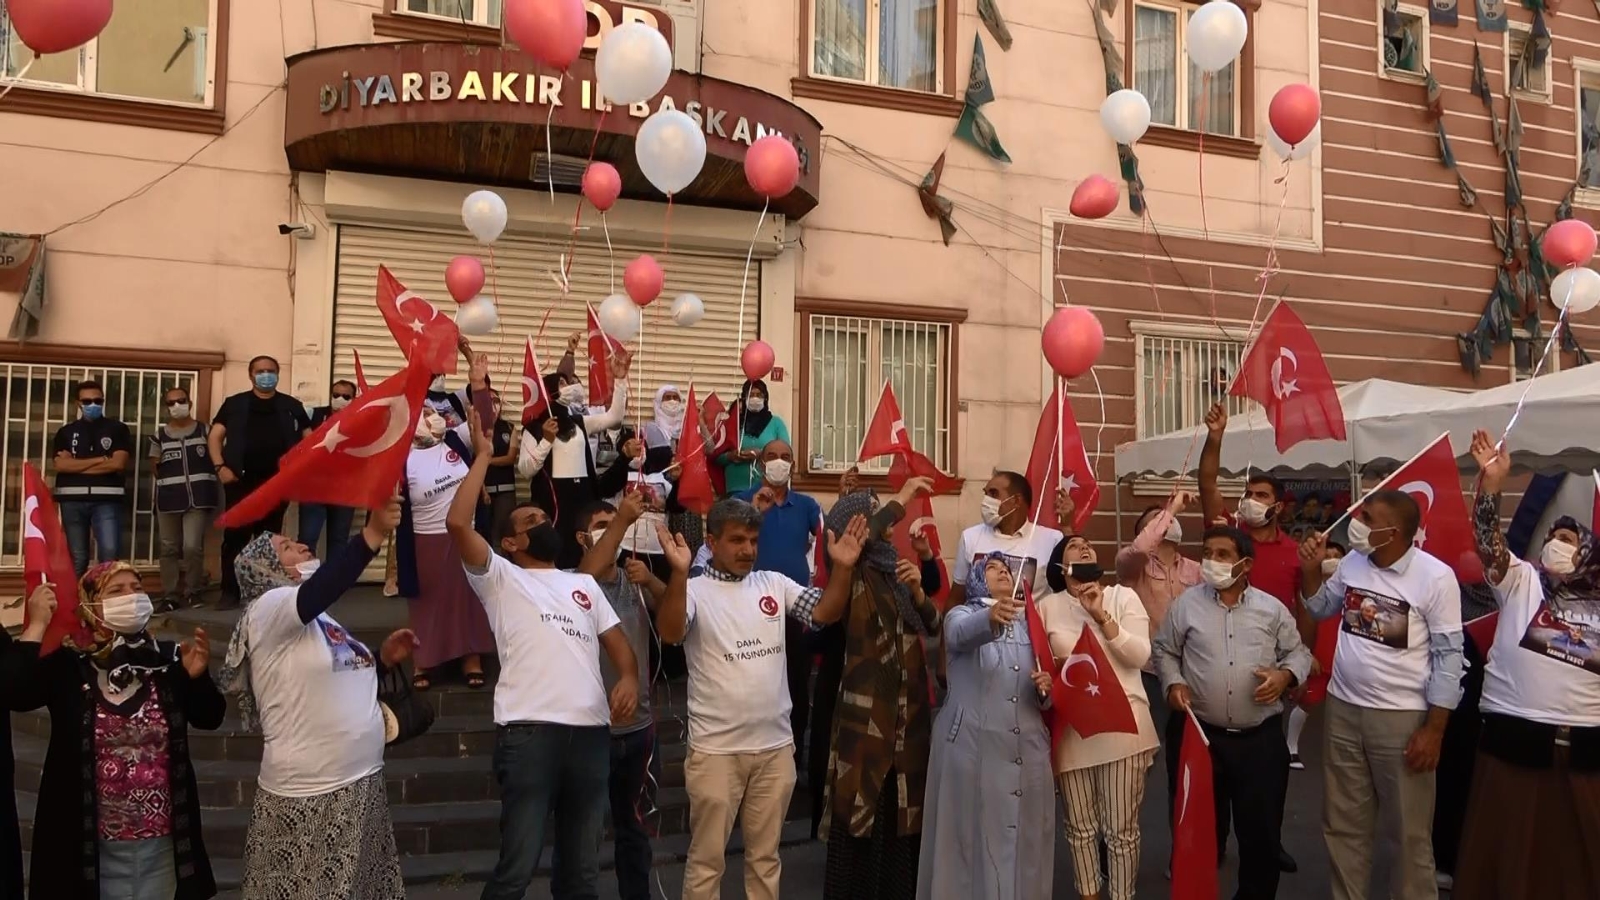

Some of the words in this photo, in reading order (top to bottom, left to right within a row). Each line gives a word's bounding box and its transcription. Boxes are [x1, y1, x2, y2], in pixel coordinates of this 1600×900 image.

[319, 70, 564, 113] DİYARBAKIR
[736, 638, 762, 648] DAHA
[723, 652, 735, 663] 15
